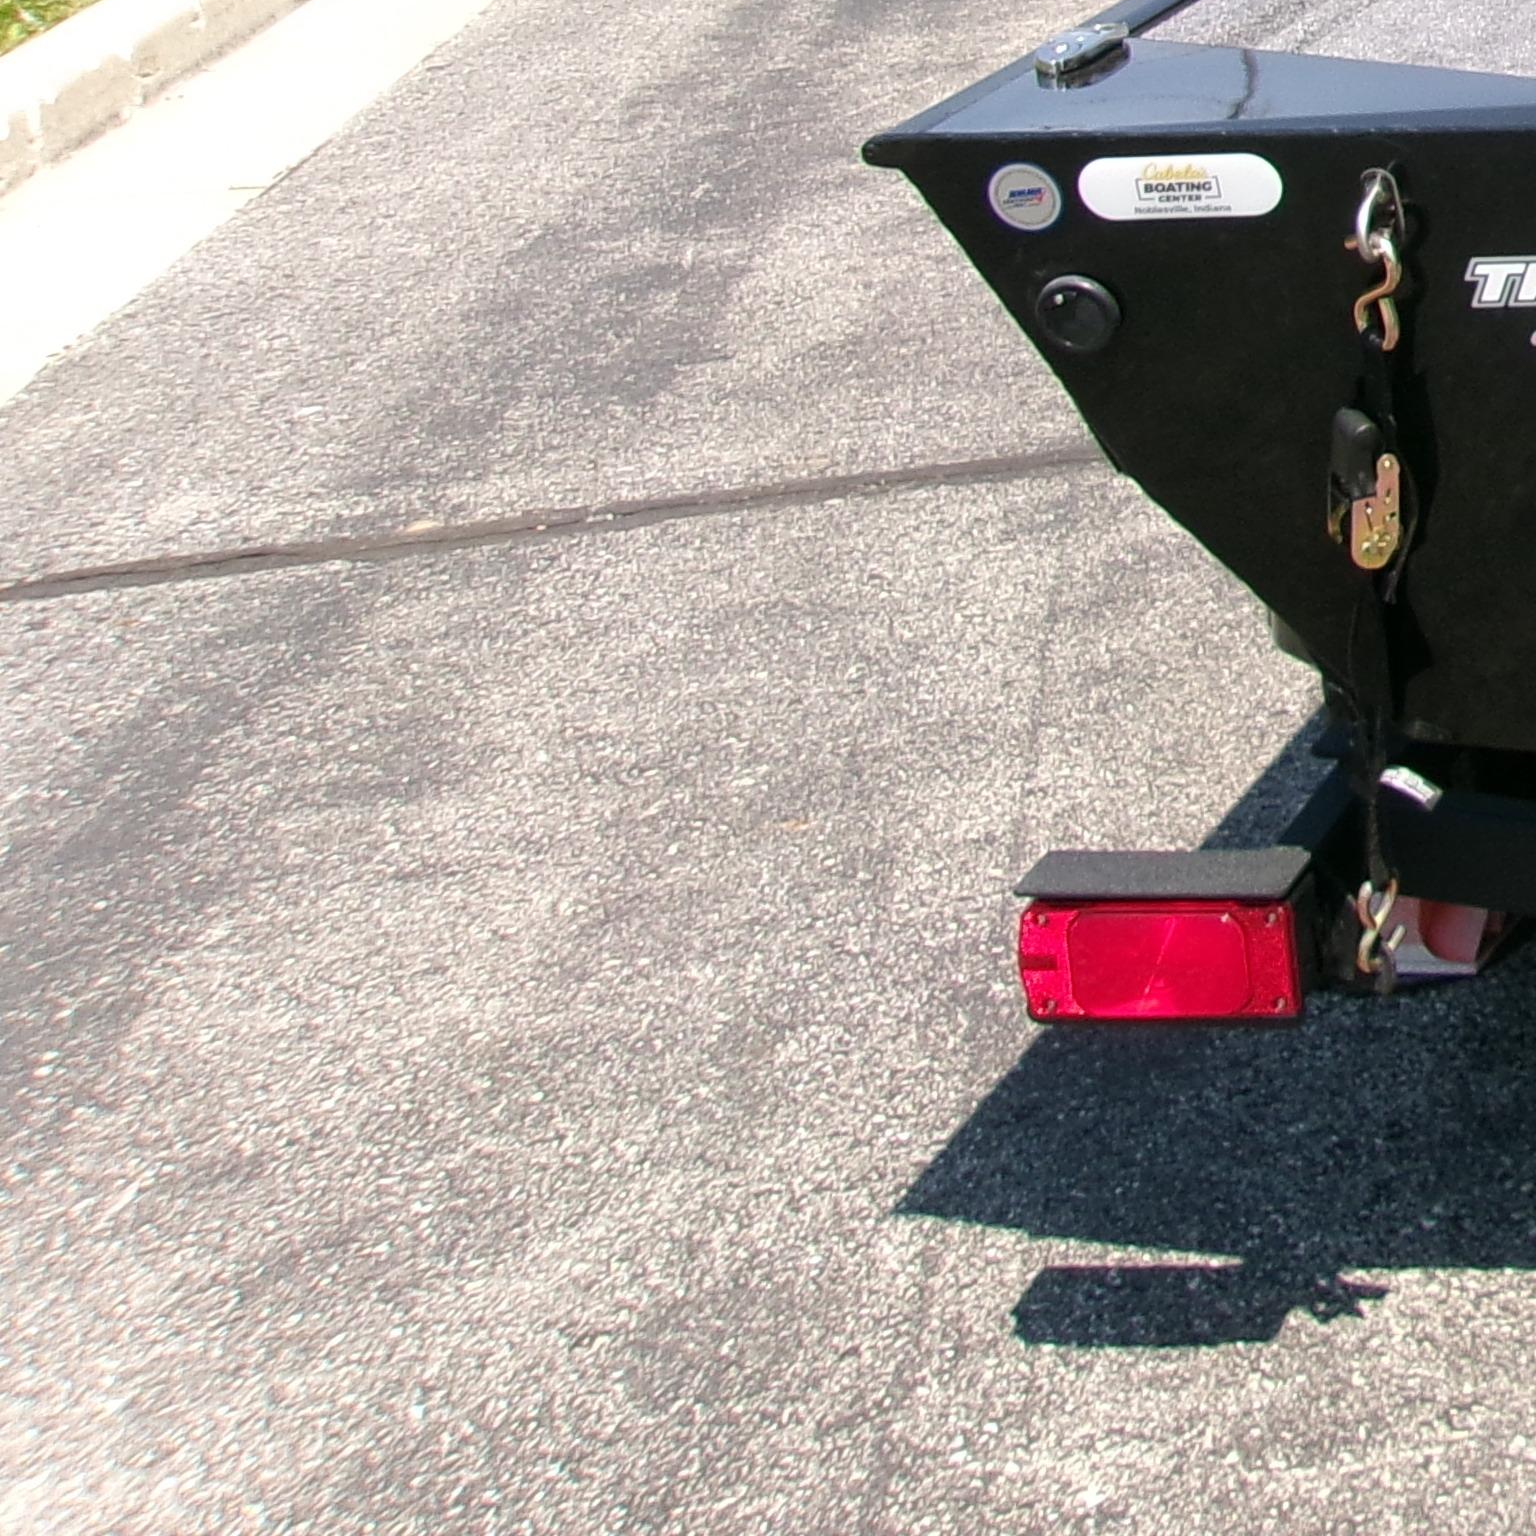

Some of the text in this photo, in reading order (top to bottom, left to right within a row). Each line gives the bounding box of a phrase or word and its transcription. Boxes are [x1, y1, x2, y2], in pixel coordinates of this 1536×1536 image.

[1144, 180, 1213, 194] BOATING
[1158, 194, 1203, 203] CENTER
[1194, 203, 1232, 214] Indiana
